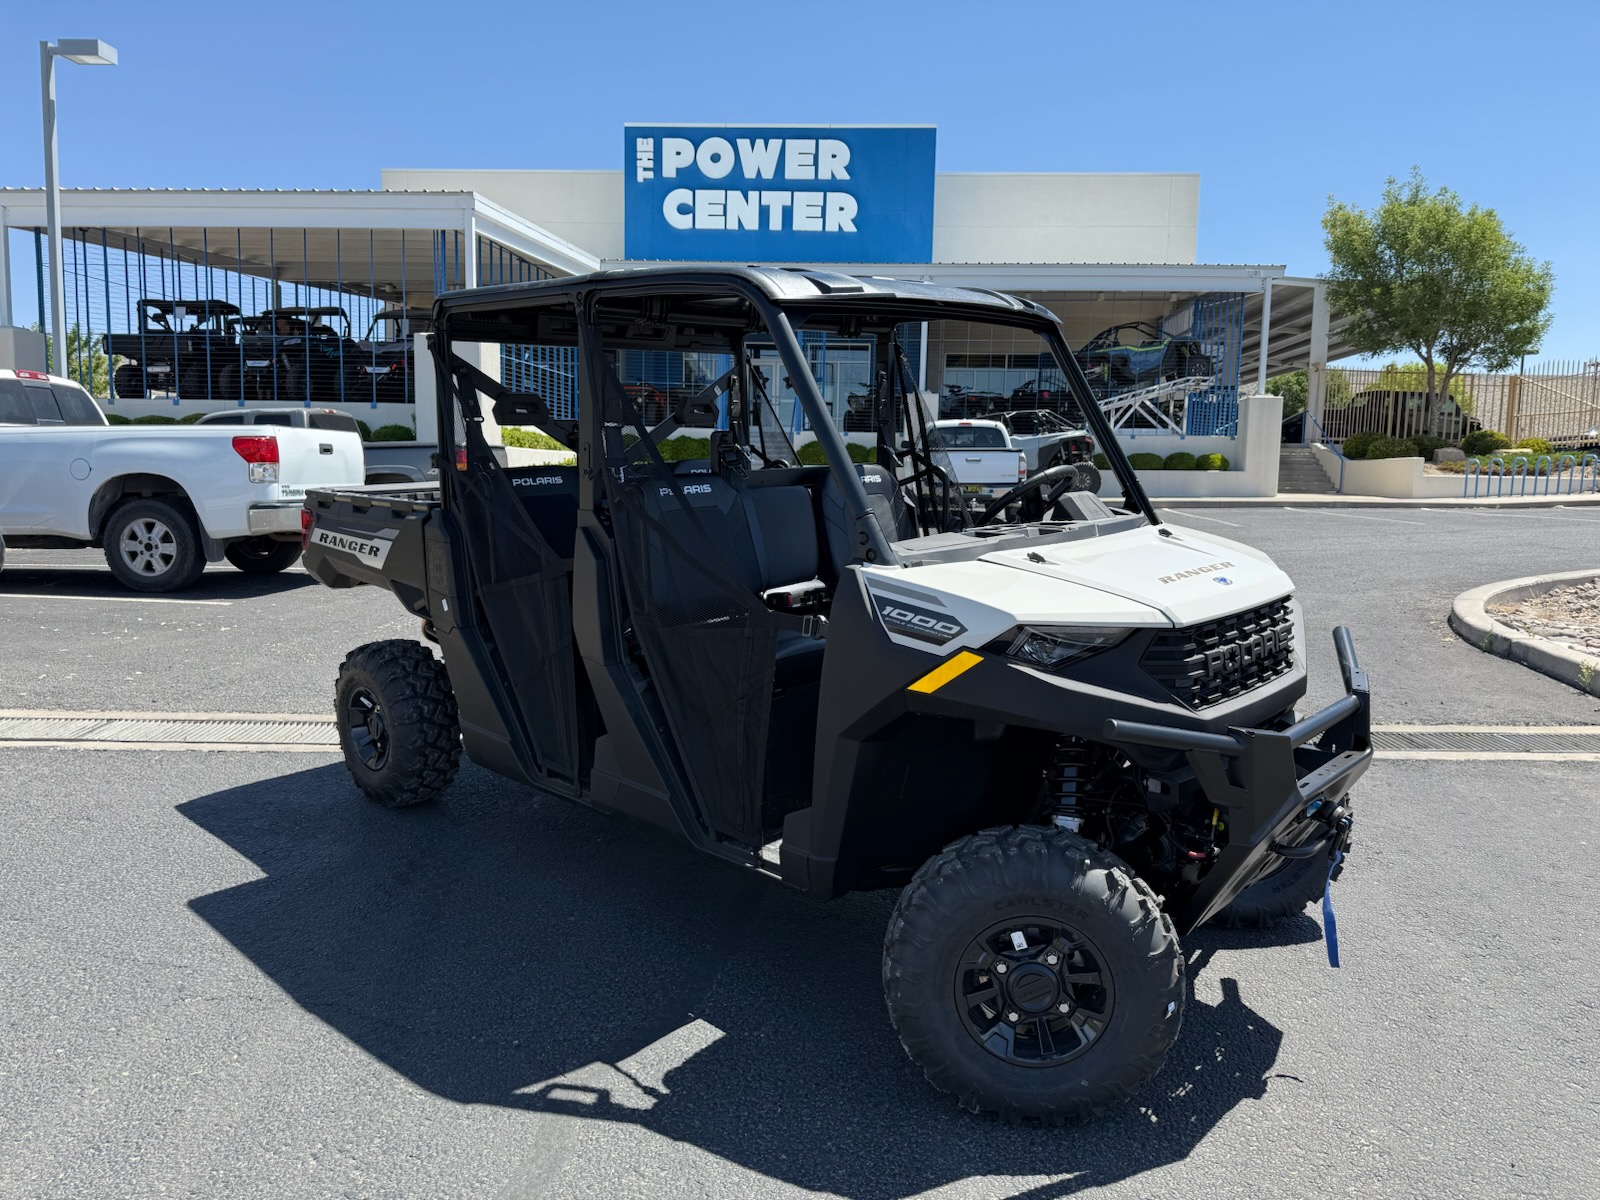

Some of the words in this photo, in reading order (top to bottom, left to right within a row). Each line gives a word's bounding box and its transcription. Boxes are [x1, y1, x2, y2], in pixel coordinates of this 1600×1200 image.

[636, 137, 654, 183] THE
[661, 136, 851, 180] POWER
[662, 188, 858, 232] CENTER
[512, 475, 564, 487] POLARIS
[319, 532, 381, 558] RANGER
[1157, 561, 1236, 585] RANGER
[881, 605, 961, 635] 1000
[1203, 621, 1295, 678] POLARIS
[993, 895, 1090, 921] CARLSTAR
